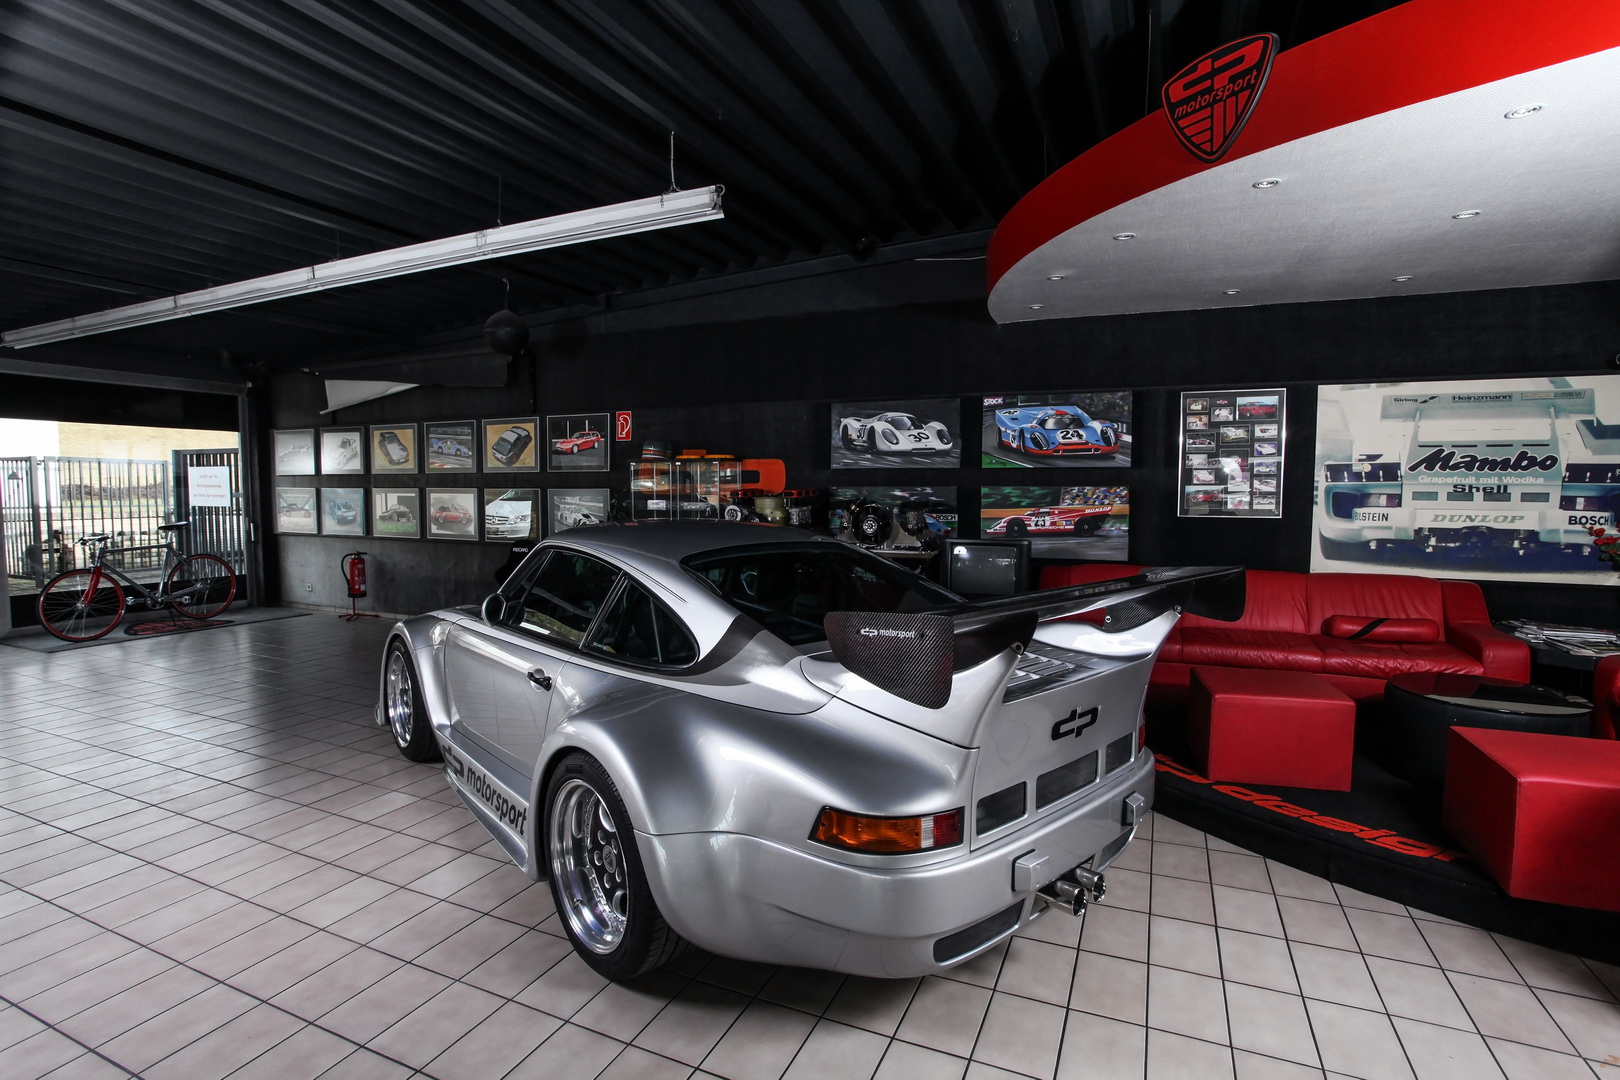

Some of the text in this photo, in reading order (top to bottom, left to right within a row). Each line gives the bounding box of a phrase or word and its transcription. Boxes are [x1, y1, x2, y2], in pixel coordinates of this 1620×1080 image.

[1174, 69, 1258, 119] motorsport
[984, 398, 1003, 406] STOCK
[1452, 394, 1512, 402] Heinzmann
[907, 432, 930, 443] 30
[1060, 430, 1084, 441] 24
[1407, 447, 1559, 473] Mambo
[1418, 475, 1545, 485] Grapefruit mit Wodka
[1452, 484, 1508, 494] Shell
[935, 514, 956, 522] BOSCH
[1430, 514, 1525, 524] DUNLOP
[1568, 515, 1610, 526] BOSCH
[879, 628, 916, 639] motorsport
[466, 766, 527, 836] motorsport
